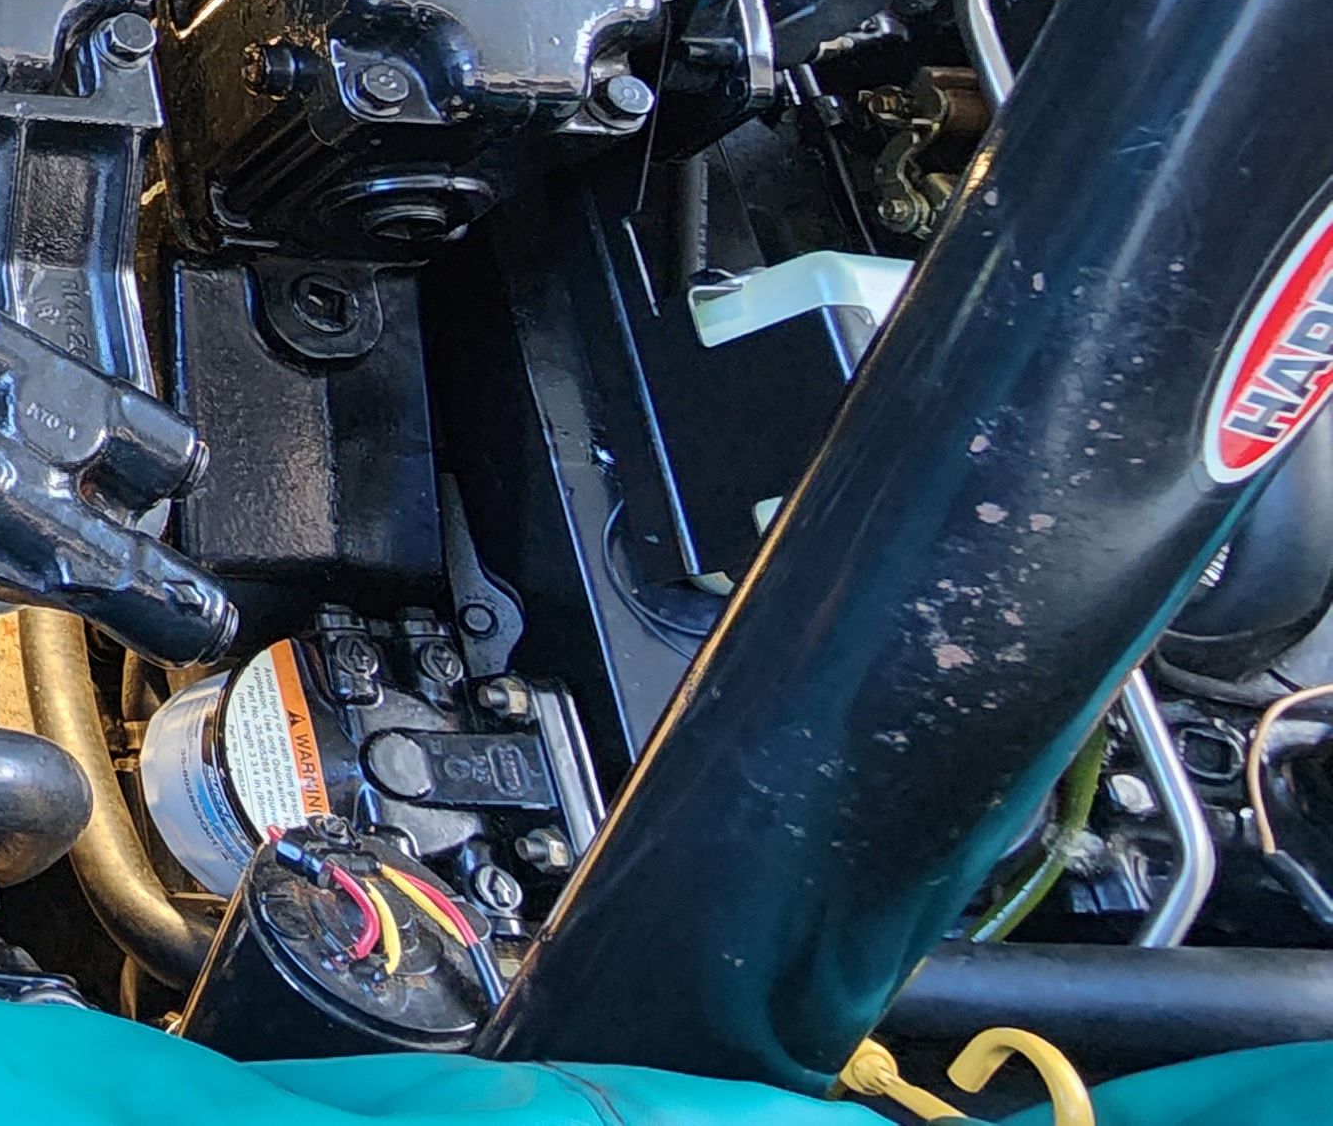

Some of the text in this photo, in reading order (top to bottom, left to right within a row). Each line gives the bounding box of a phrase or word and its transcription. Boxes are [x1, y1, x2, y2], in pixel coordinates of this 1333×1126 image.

[1222, 270, 1333, 442] HAR
[246, 683, 256, 703] Part
[250, 704, 259, 720] No.
[262, 713, 273, 732] Use
[241, 719, 254, 749] length
[265, 734, 277, 755] only
[263, 666, 302, 826] Avoid injury or death from gasoli
[264, 776, 271, 786] or
[271, 758, 288, 813] Quicksilver
